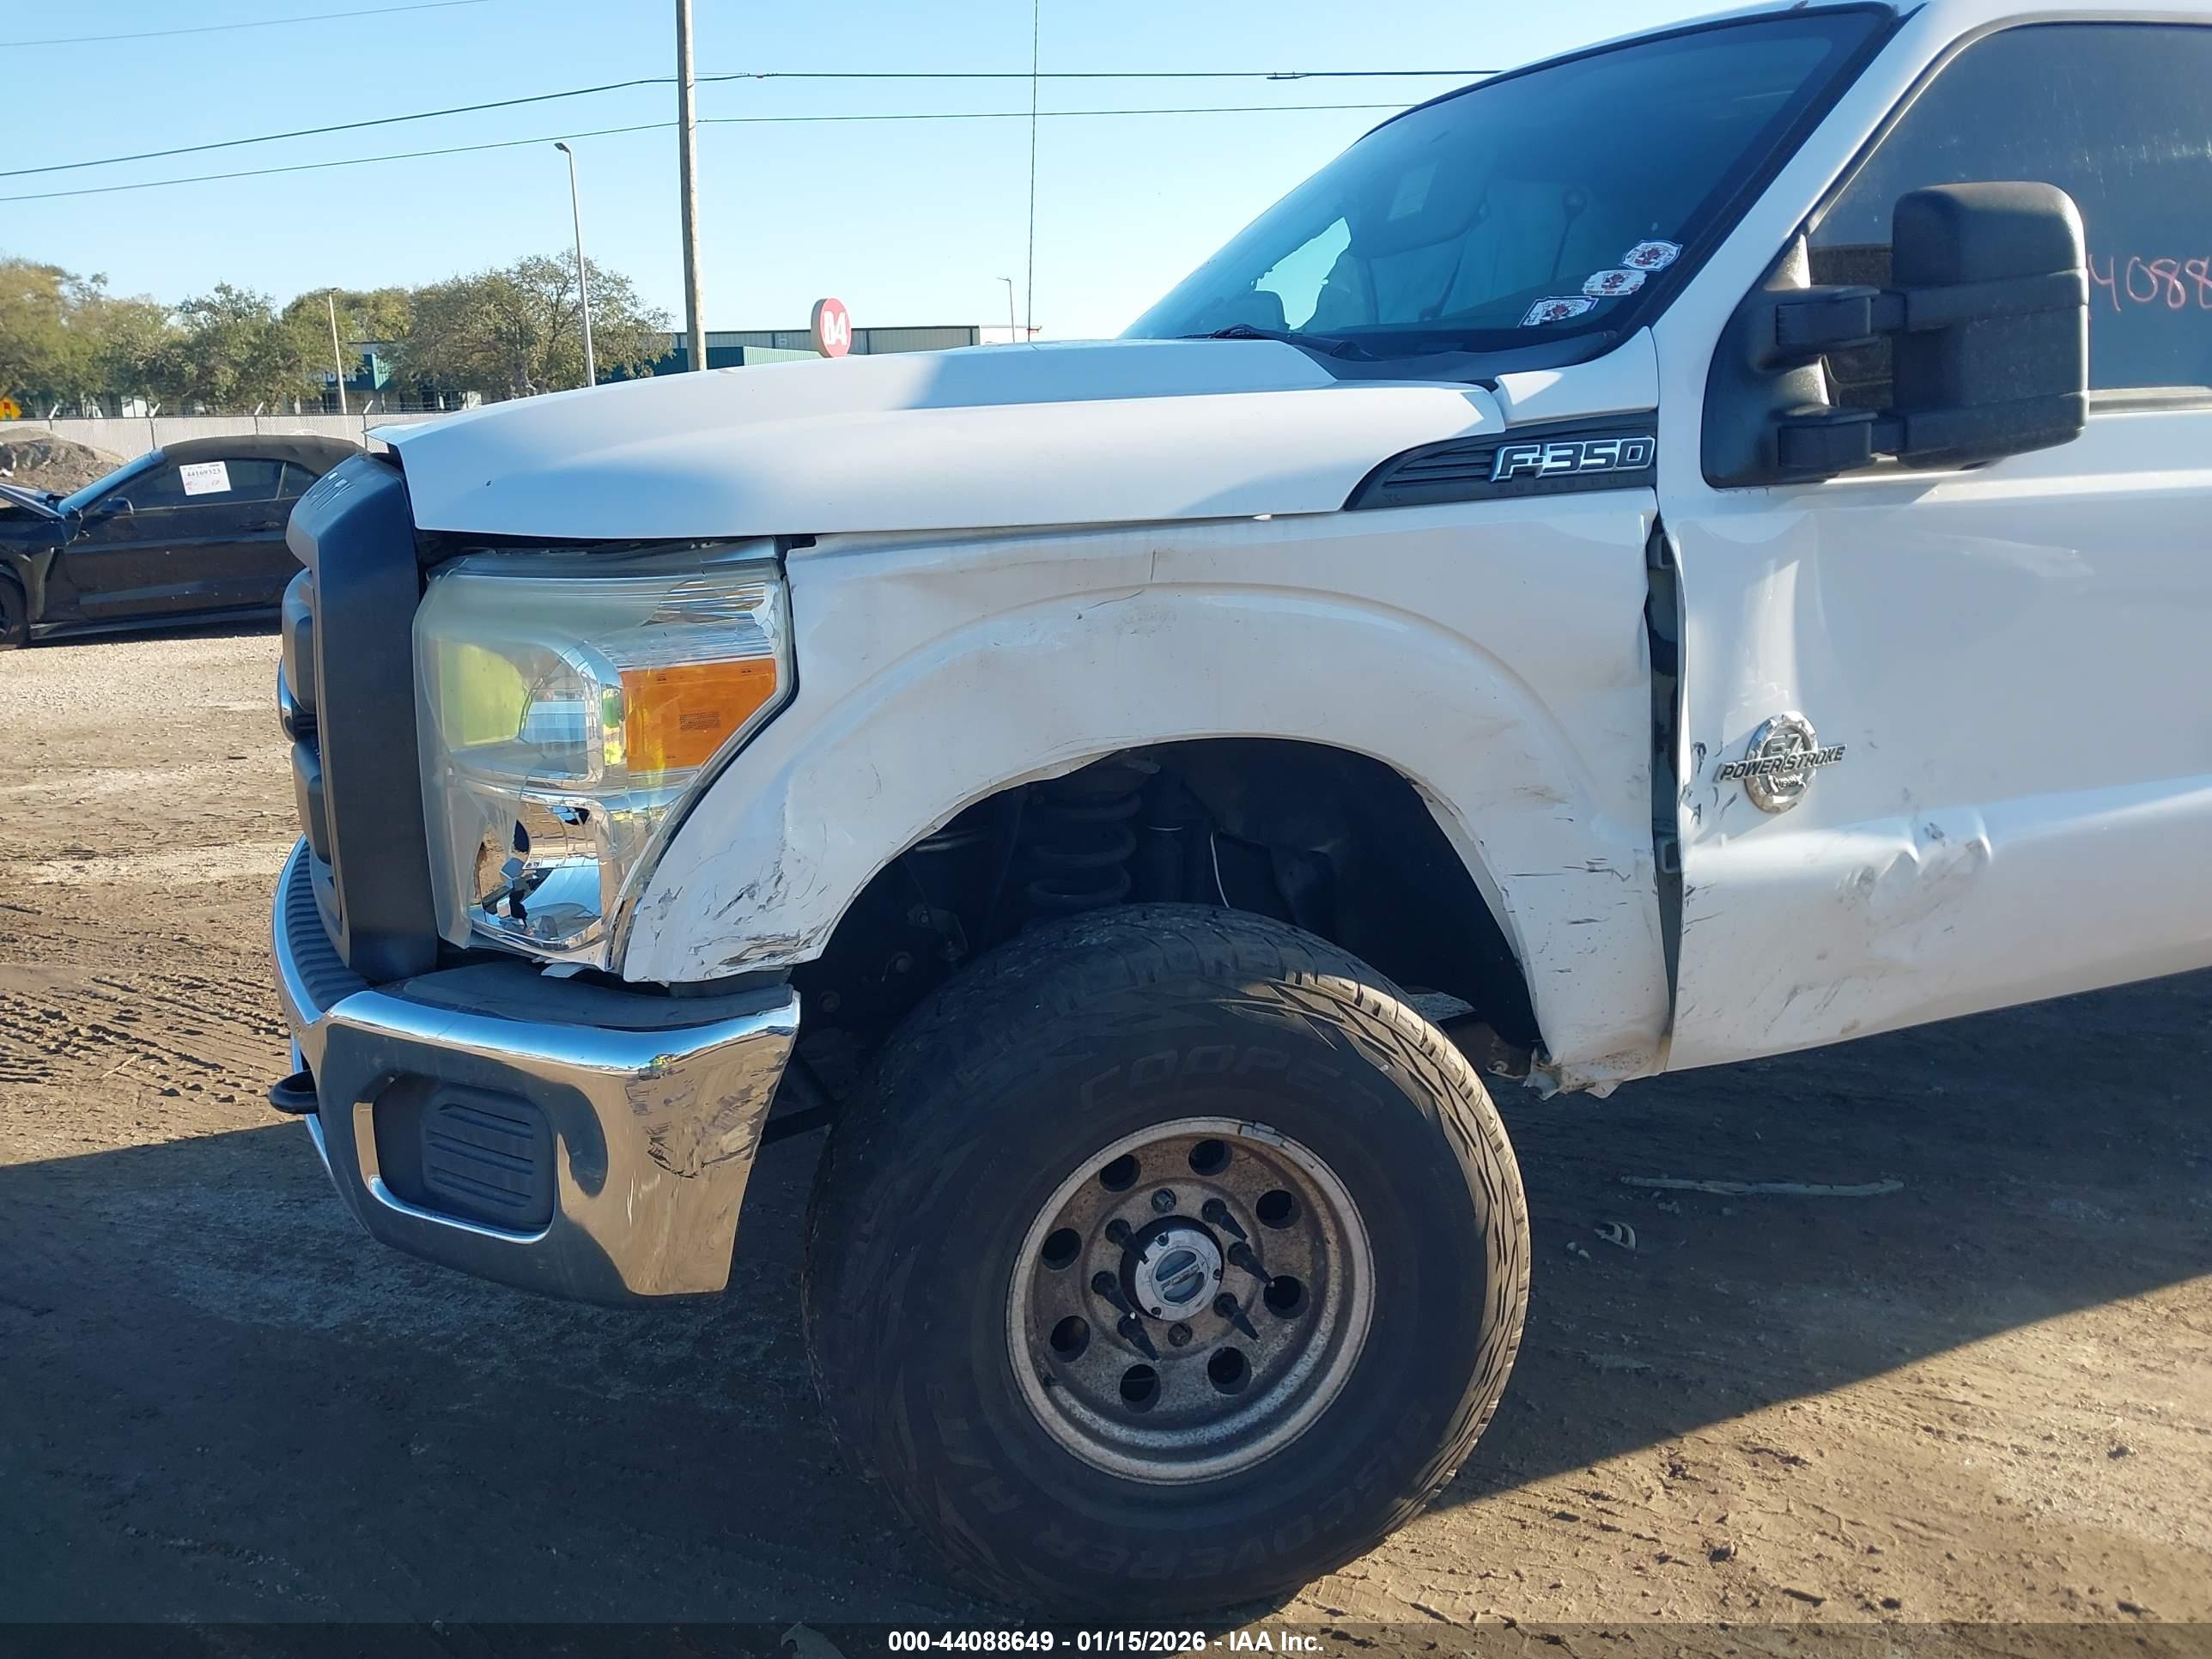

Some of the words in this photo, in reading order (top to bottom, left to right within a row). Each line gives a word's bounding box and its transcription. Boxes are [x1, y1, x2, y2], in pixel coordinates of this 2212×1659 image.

[1720, 754, 1784, 780] POWER
[1783, 745, 1846, 771] STROKE
[1079, 1043, 1385, 1125] COOPER
